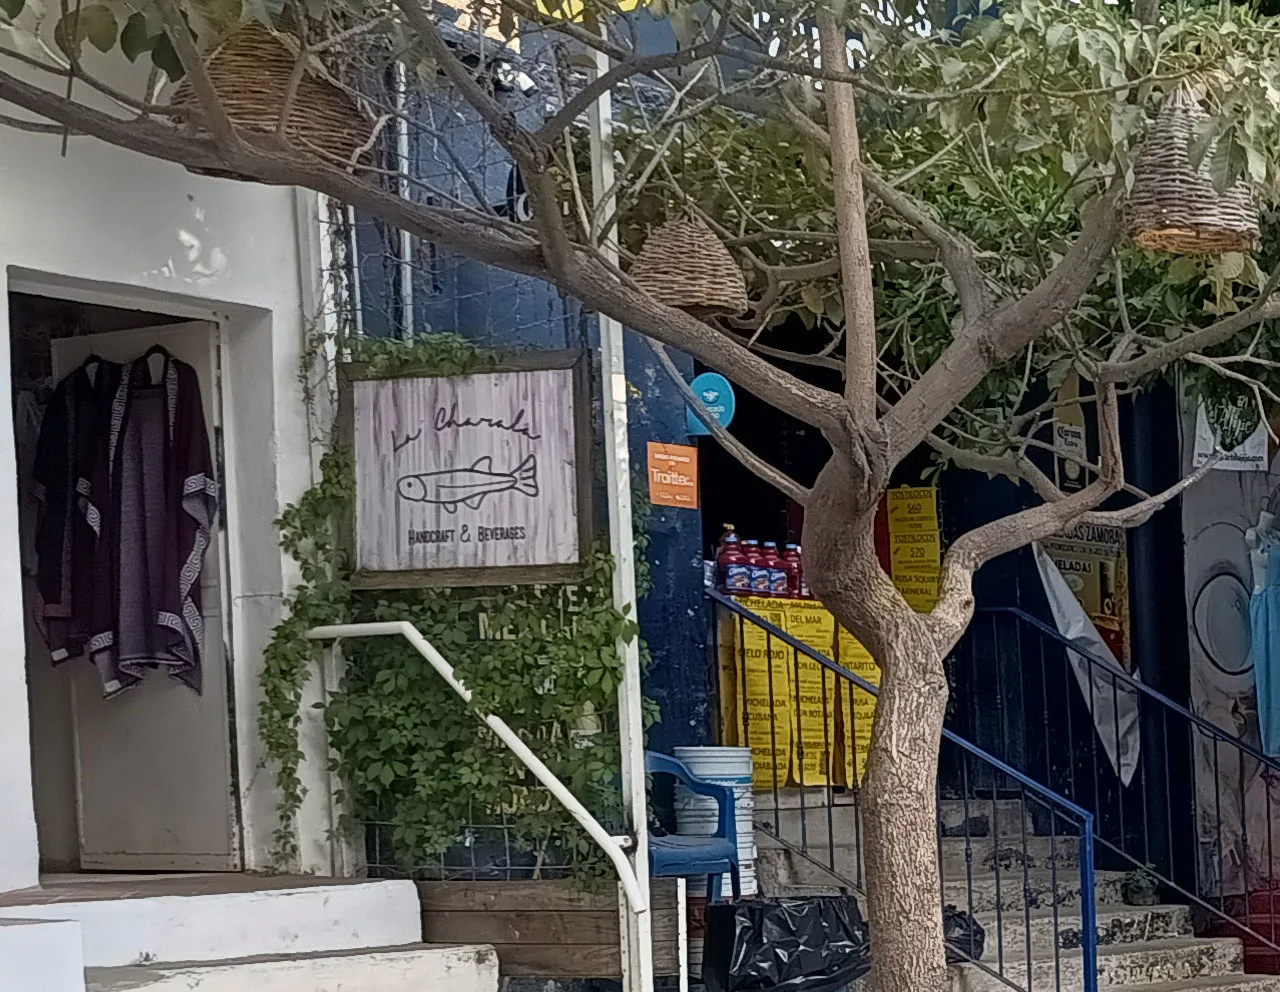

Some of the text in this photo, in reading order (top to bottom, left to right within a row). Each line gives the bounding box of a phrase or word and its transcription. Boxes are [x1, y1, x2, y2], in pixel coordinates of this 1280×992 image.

[408, 523, 527, 545] HANDCRAFT & BEVERAGES
